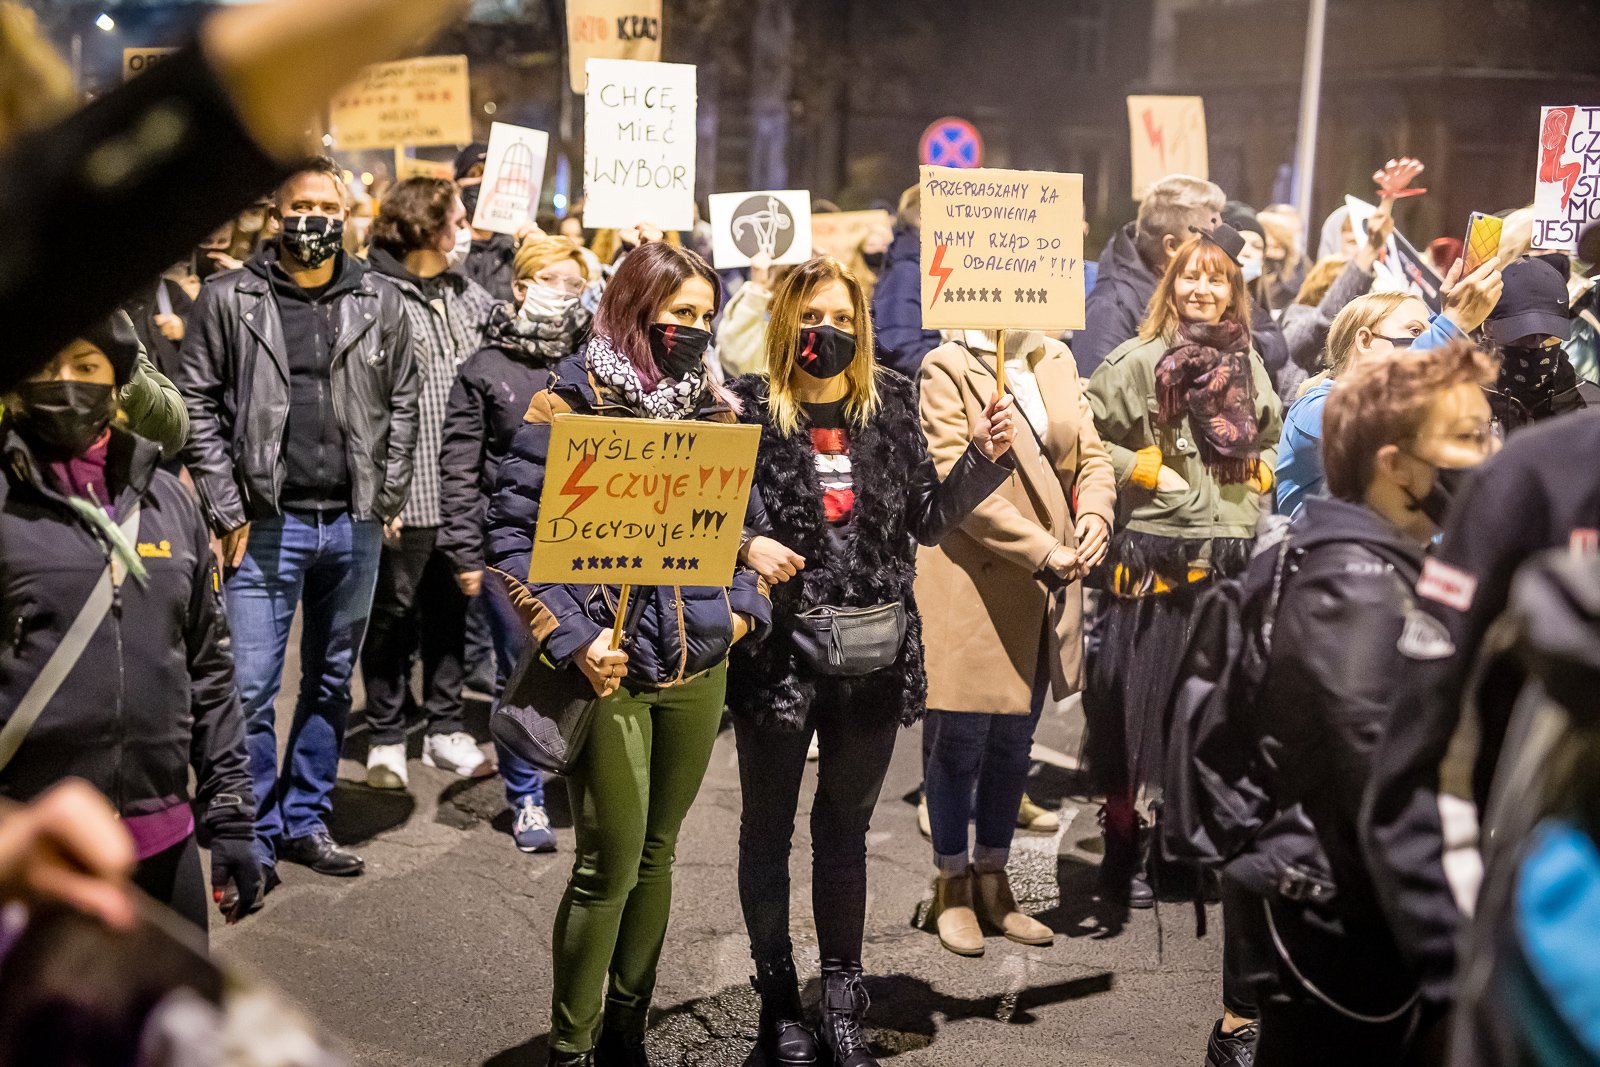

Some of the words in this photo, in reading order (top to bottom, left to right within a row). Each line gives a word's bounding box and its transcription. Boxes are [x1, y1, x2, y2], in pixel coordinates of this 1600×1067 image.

[600, 84, 676, 114] CHCĘ
[593, 154, 688, 190] WYBÓR
[1040, 185, 1059, 204] ZA
[946, 204, 1037, 223] UTRUDNIENIA
[933, 230, 975, 248] MAMY
[989, 232, 1029, 253] RZĄD
[1037, 238, 1061, 250] DO
[1532, 219, 1580, 246] JEST
